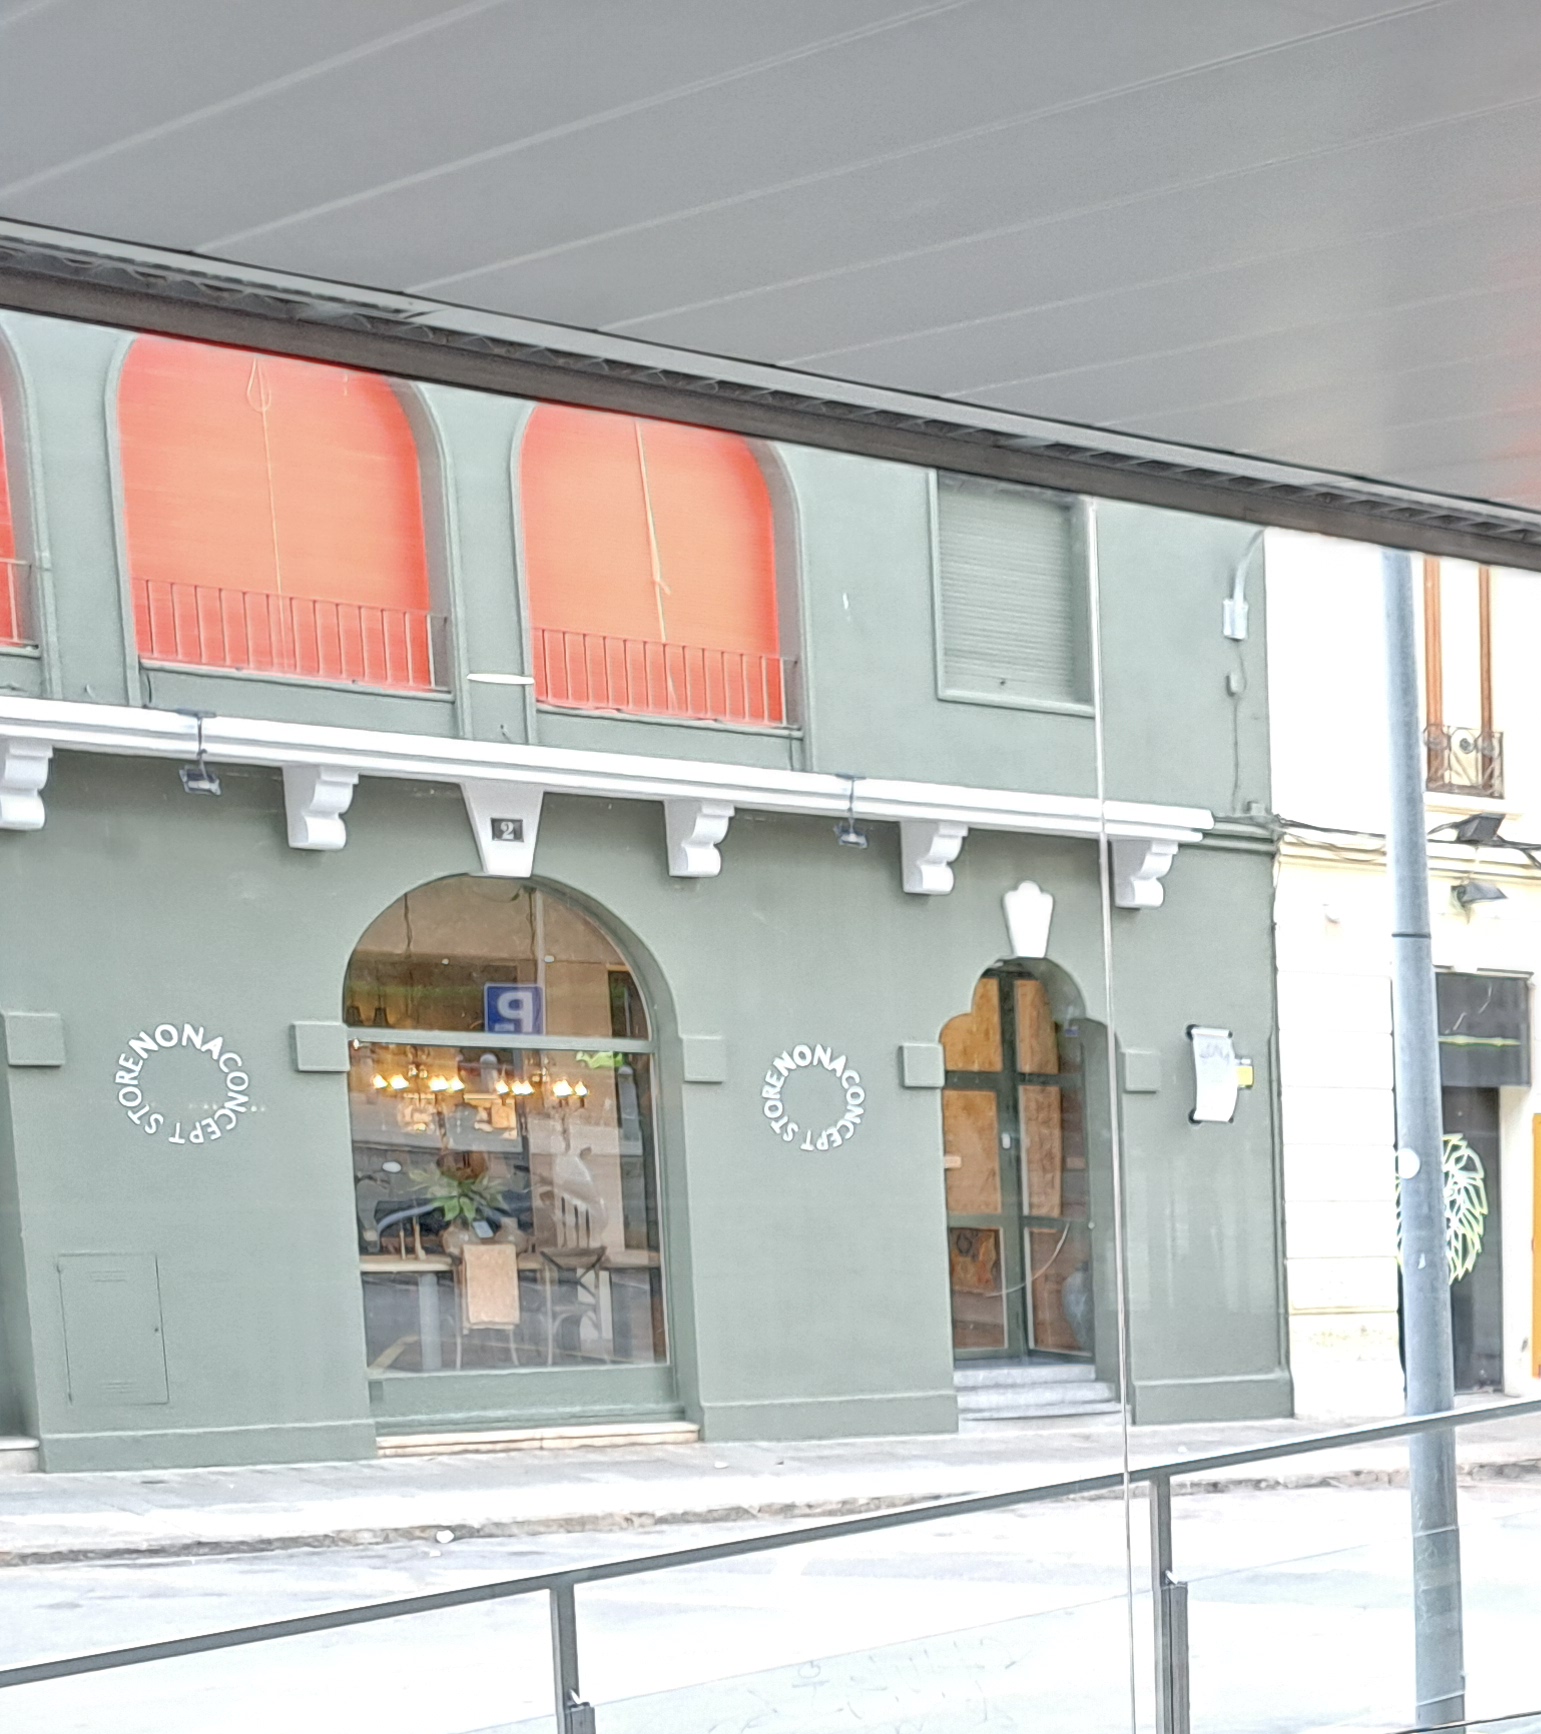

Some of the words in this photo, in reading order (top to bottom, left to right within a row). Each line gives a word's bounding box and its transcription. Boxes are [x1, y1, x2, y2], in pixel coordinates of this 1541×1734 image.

[500, 821, 514, 840] 2
[128, 1022, 223, 1060] NONA
[772, 1043, 847, 1078] NONA
[115, 1053, 164, 1134] STORE
[168, 1052, 249, 1144] CONCEPT
[761, 1070, 799, 1142] STORE
[800, 1069, 865, 1151] CONCEPT
